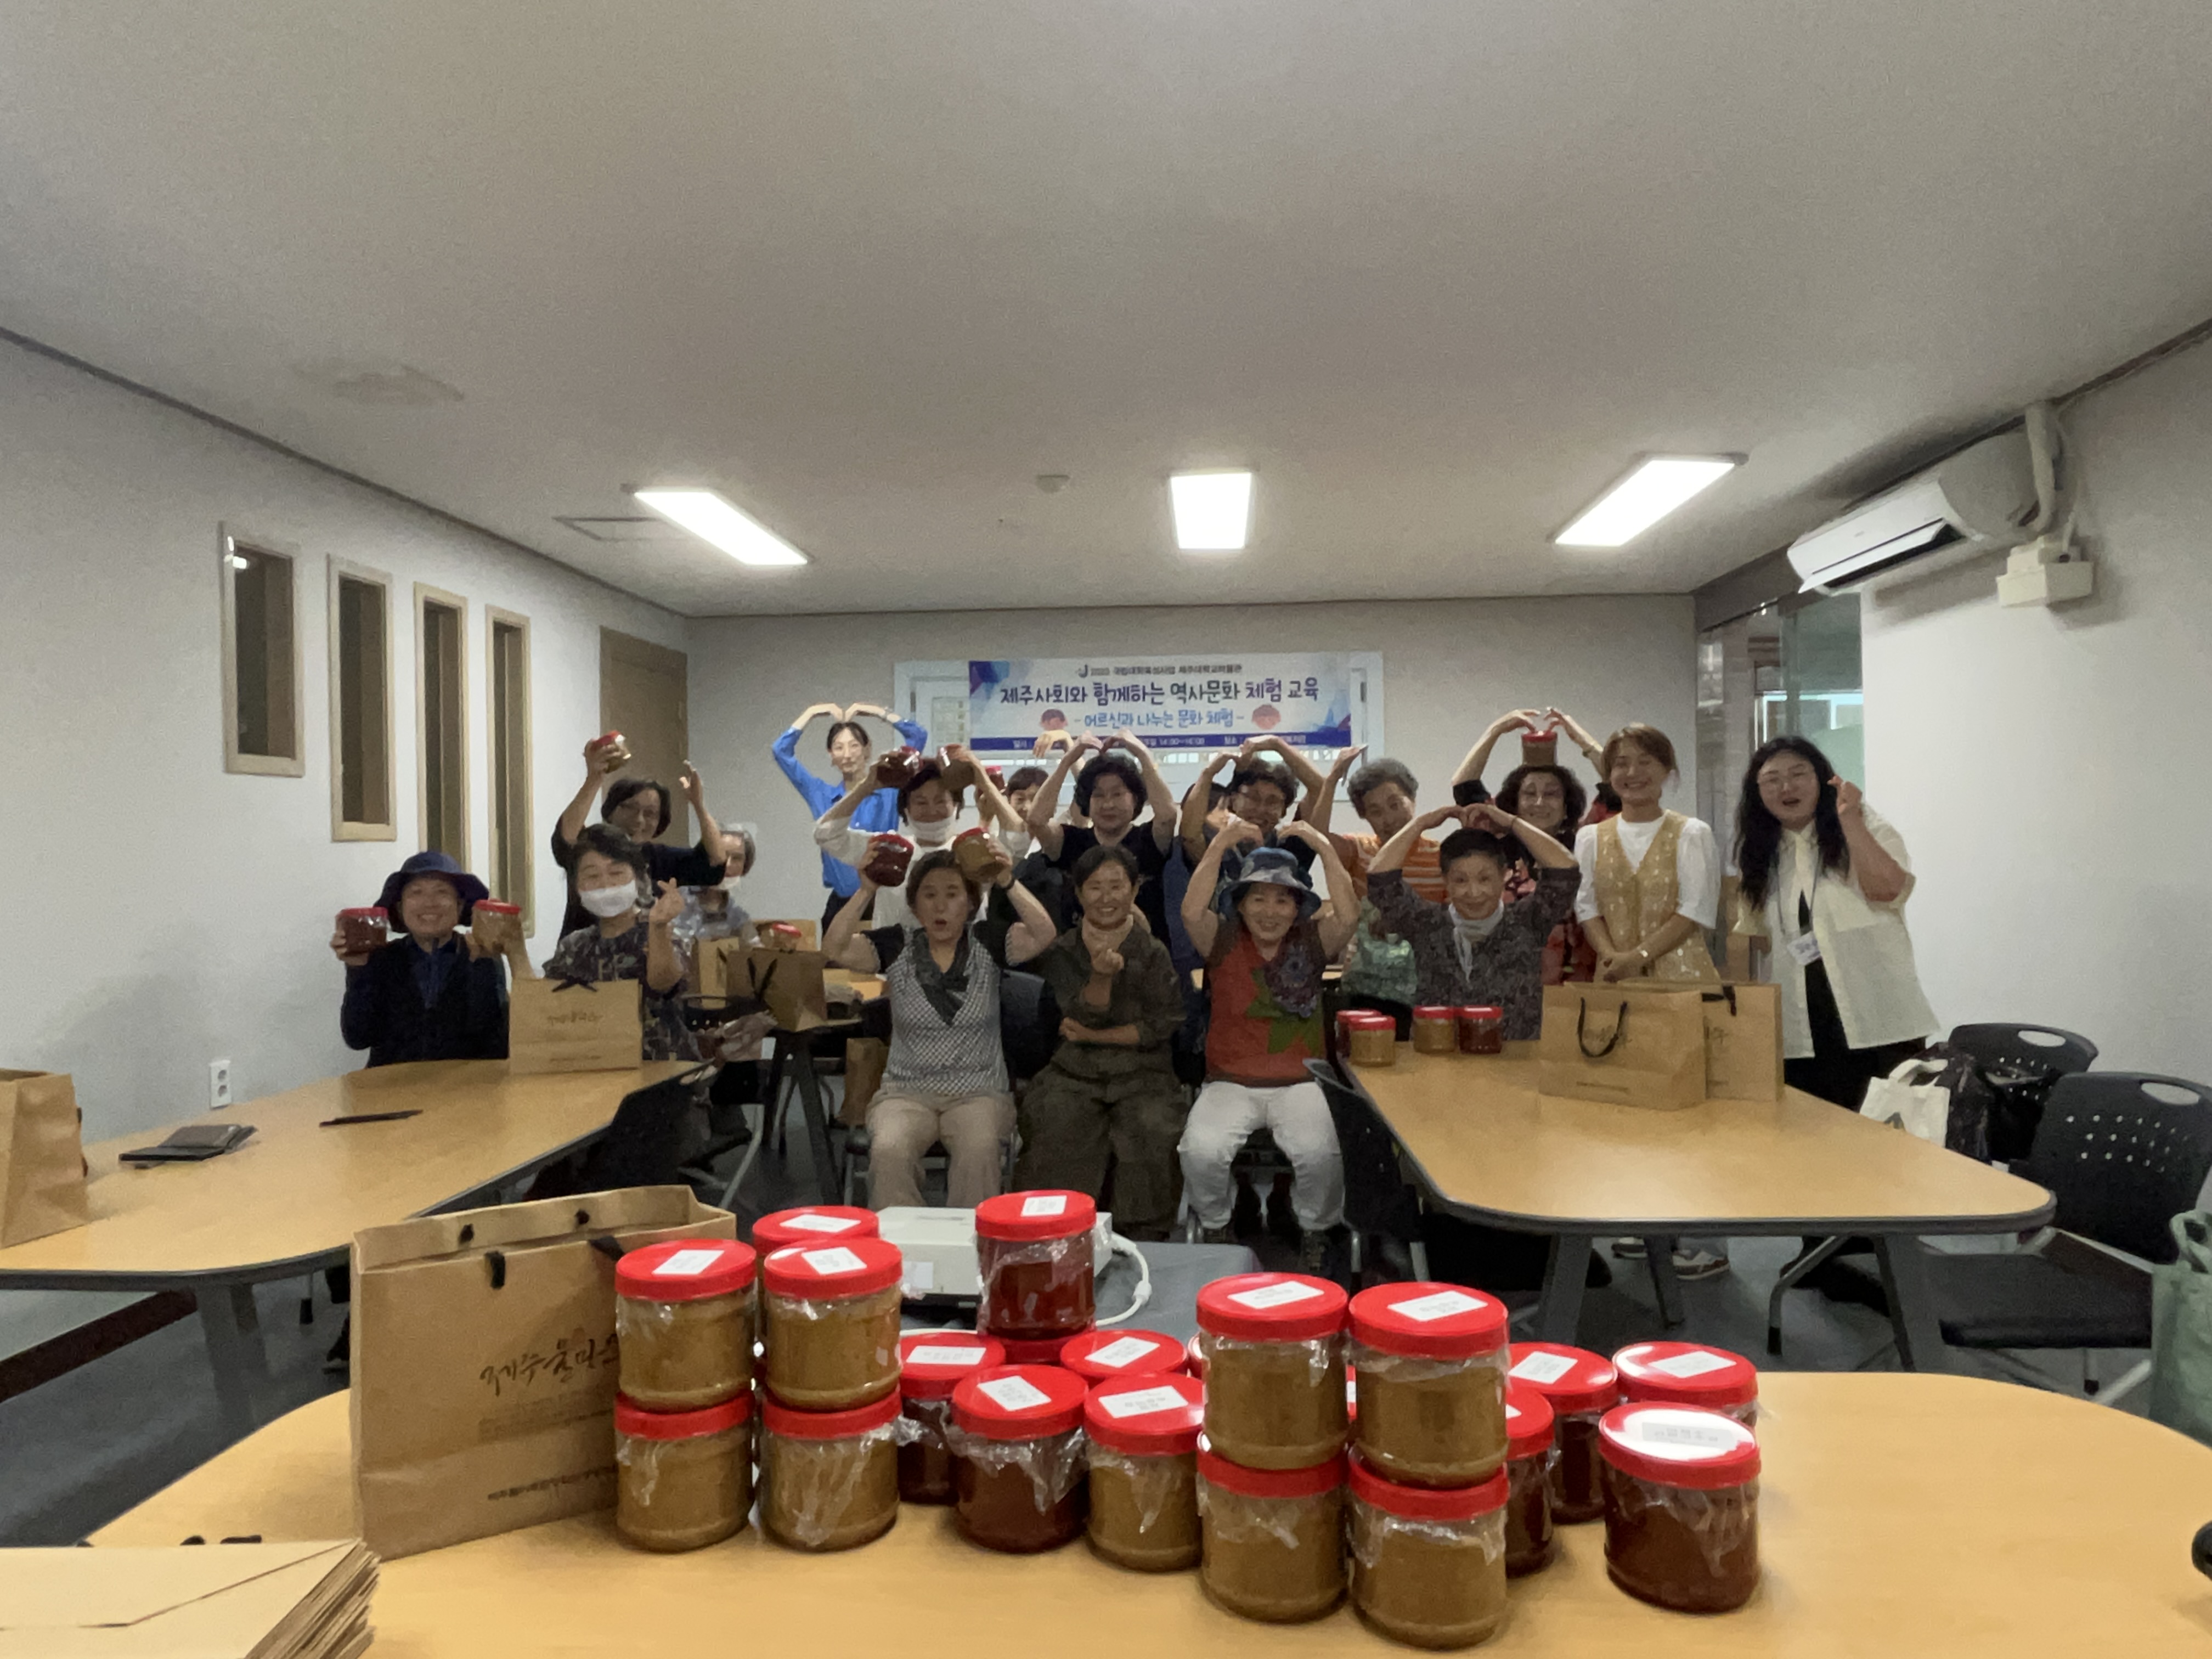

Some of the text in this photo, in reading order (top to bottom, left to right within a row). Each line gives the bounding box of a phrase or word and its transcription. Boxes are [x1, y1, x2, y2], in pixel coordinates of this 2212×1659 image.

[1000, 676, 1319, 706] 제주사회와 함께하는 역사문화 체험 교육
[1084, 712, 1134, 729] 어르신과
[1137, 710, 1174, 729] 나누는
[1178, 709, 1203, 728] 문화
[1206, 707, 1234, 728] 체험
